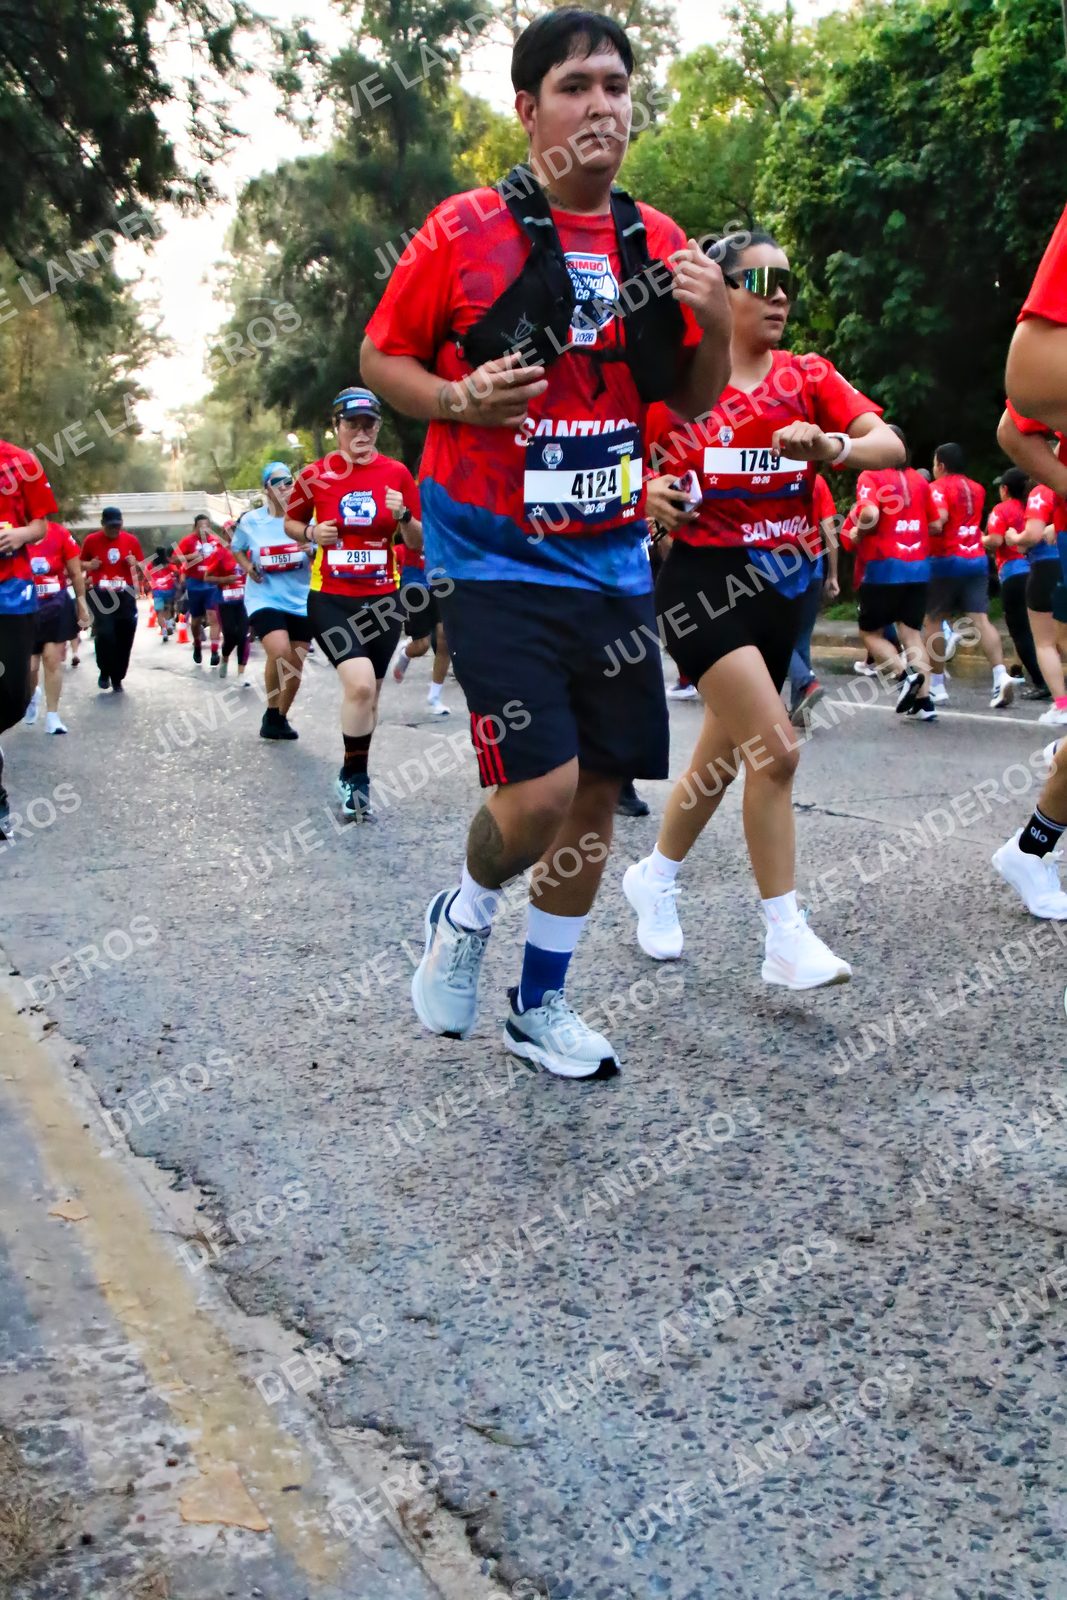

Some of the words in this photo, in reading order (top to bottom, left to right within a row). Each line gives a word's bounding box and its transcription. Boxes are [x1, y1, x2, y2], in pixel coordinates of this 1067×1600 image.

[739, 449, 781, 472] 1749
[570, 468, 618, 499] 4124
[346, 550, 371, 564] 2931
[1030, 826, 1048, 843] alo
